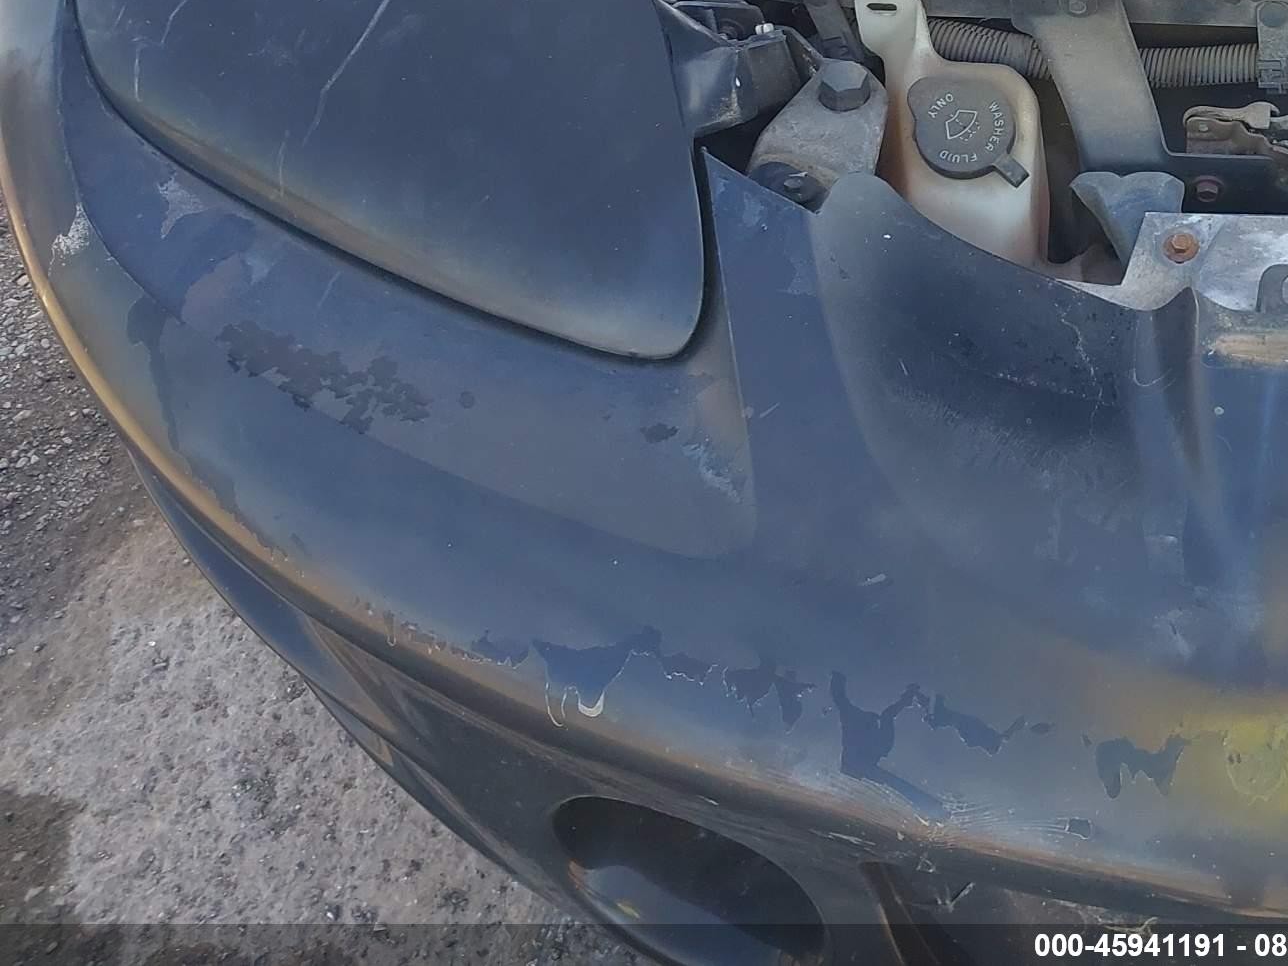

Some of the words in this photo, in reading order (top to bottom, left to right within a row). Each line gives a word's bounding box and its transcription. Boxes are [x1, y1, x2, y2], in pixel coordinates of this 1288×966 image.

[927, 92, 955, 119] ONLY
[984, 101, 1005, 152] WASHER
[939, 149, 978, 163] FLUID
